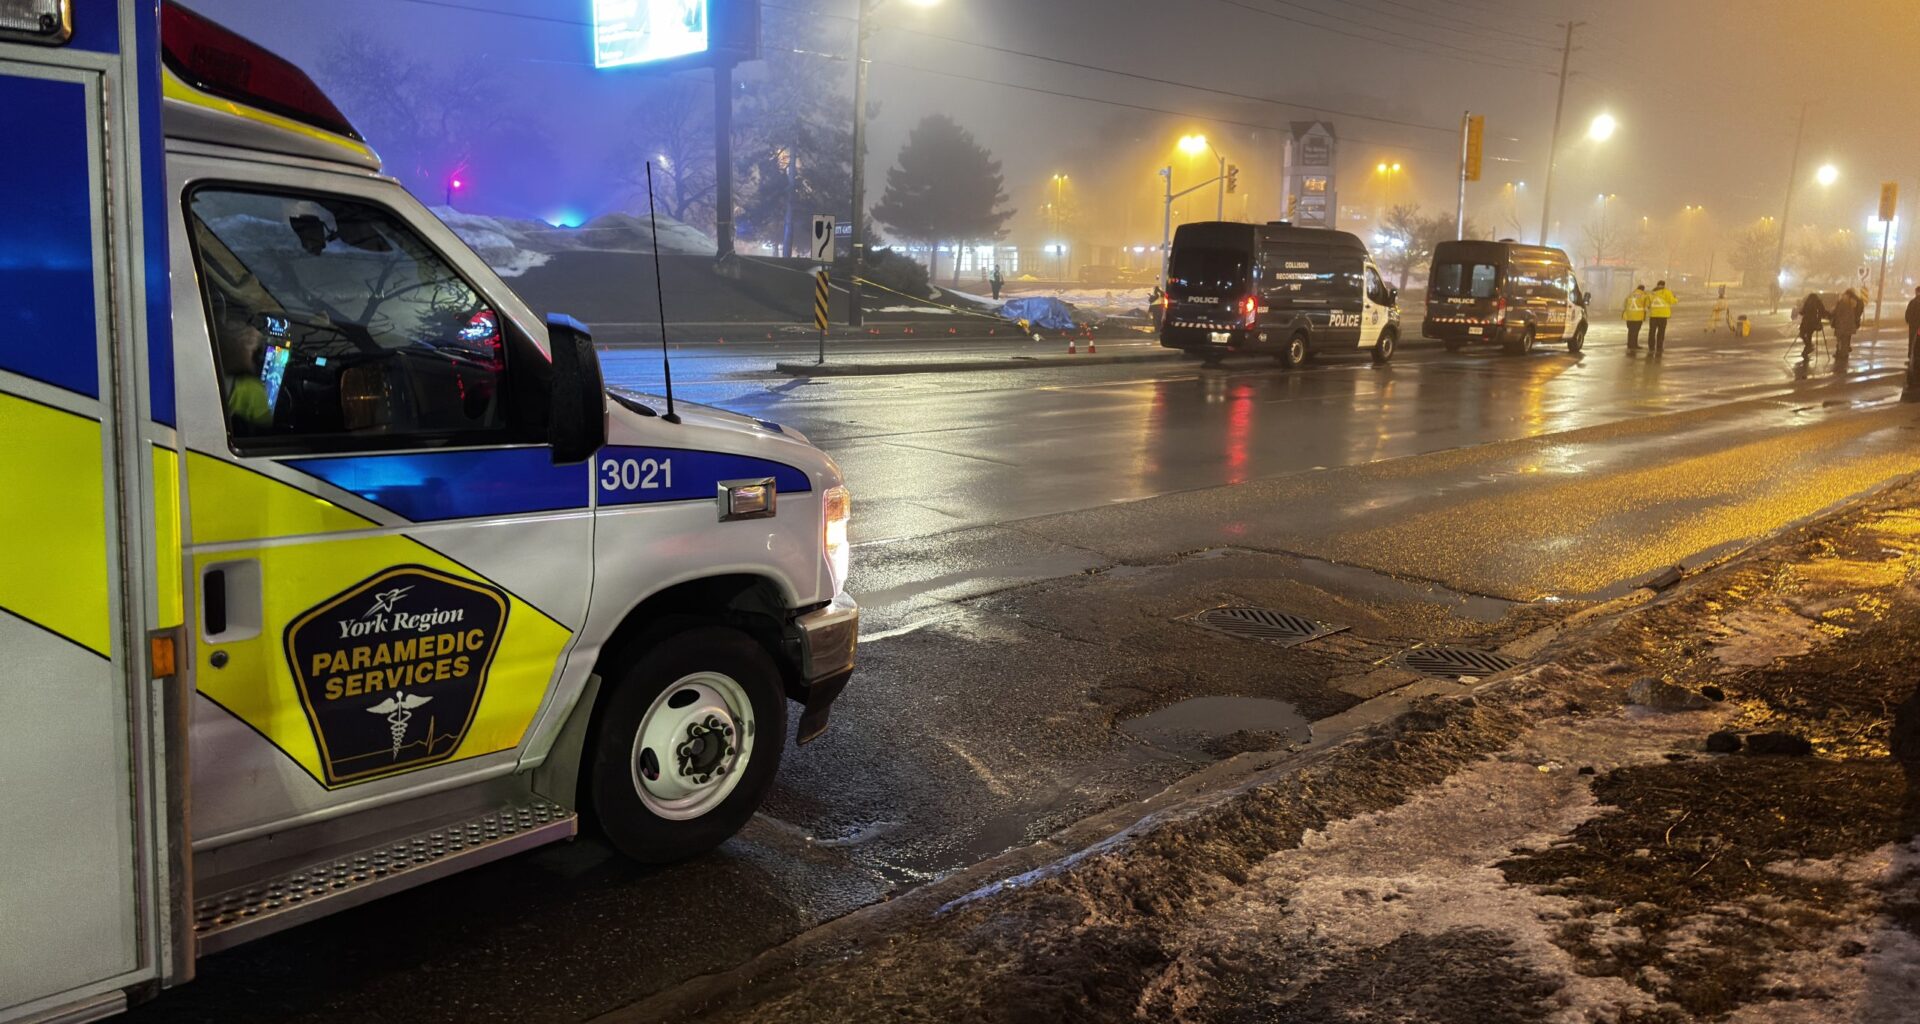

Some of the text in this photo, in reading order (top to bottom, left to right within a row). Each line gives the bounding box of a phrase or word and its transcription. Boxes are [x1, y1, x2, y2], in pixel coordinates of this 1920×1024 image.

[1285, 261, 1309, 269] COLLISION
[1188, 296, 1219, 304] POLICE
[1329, 314, 1360, 327] POLICE
[601, 458, 672, 491] 3021
[338, 606, 465, 640] York Region
[311, 628, 485, 677] PARAMEDIC
[324, 656, 471, 701] SERVICES
